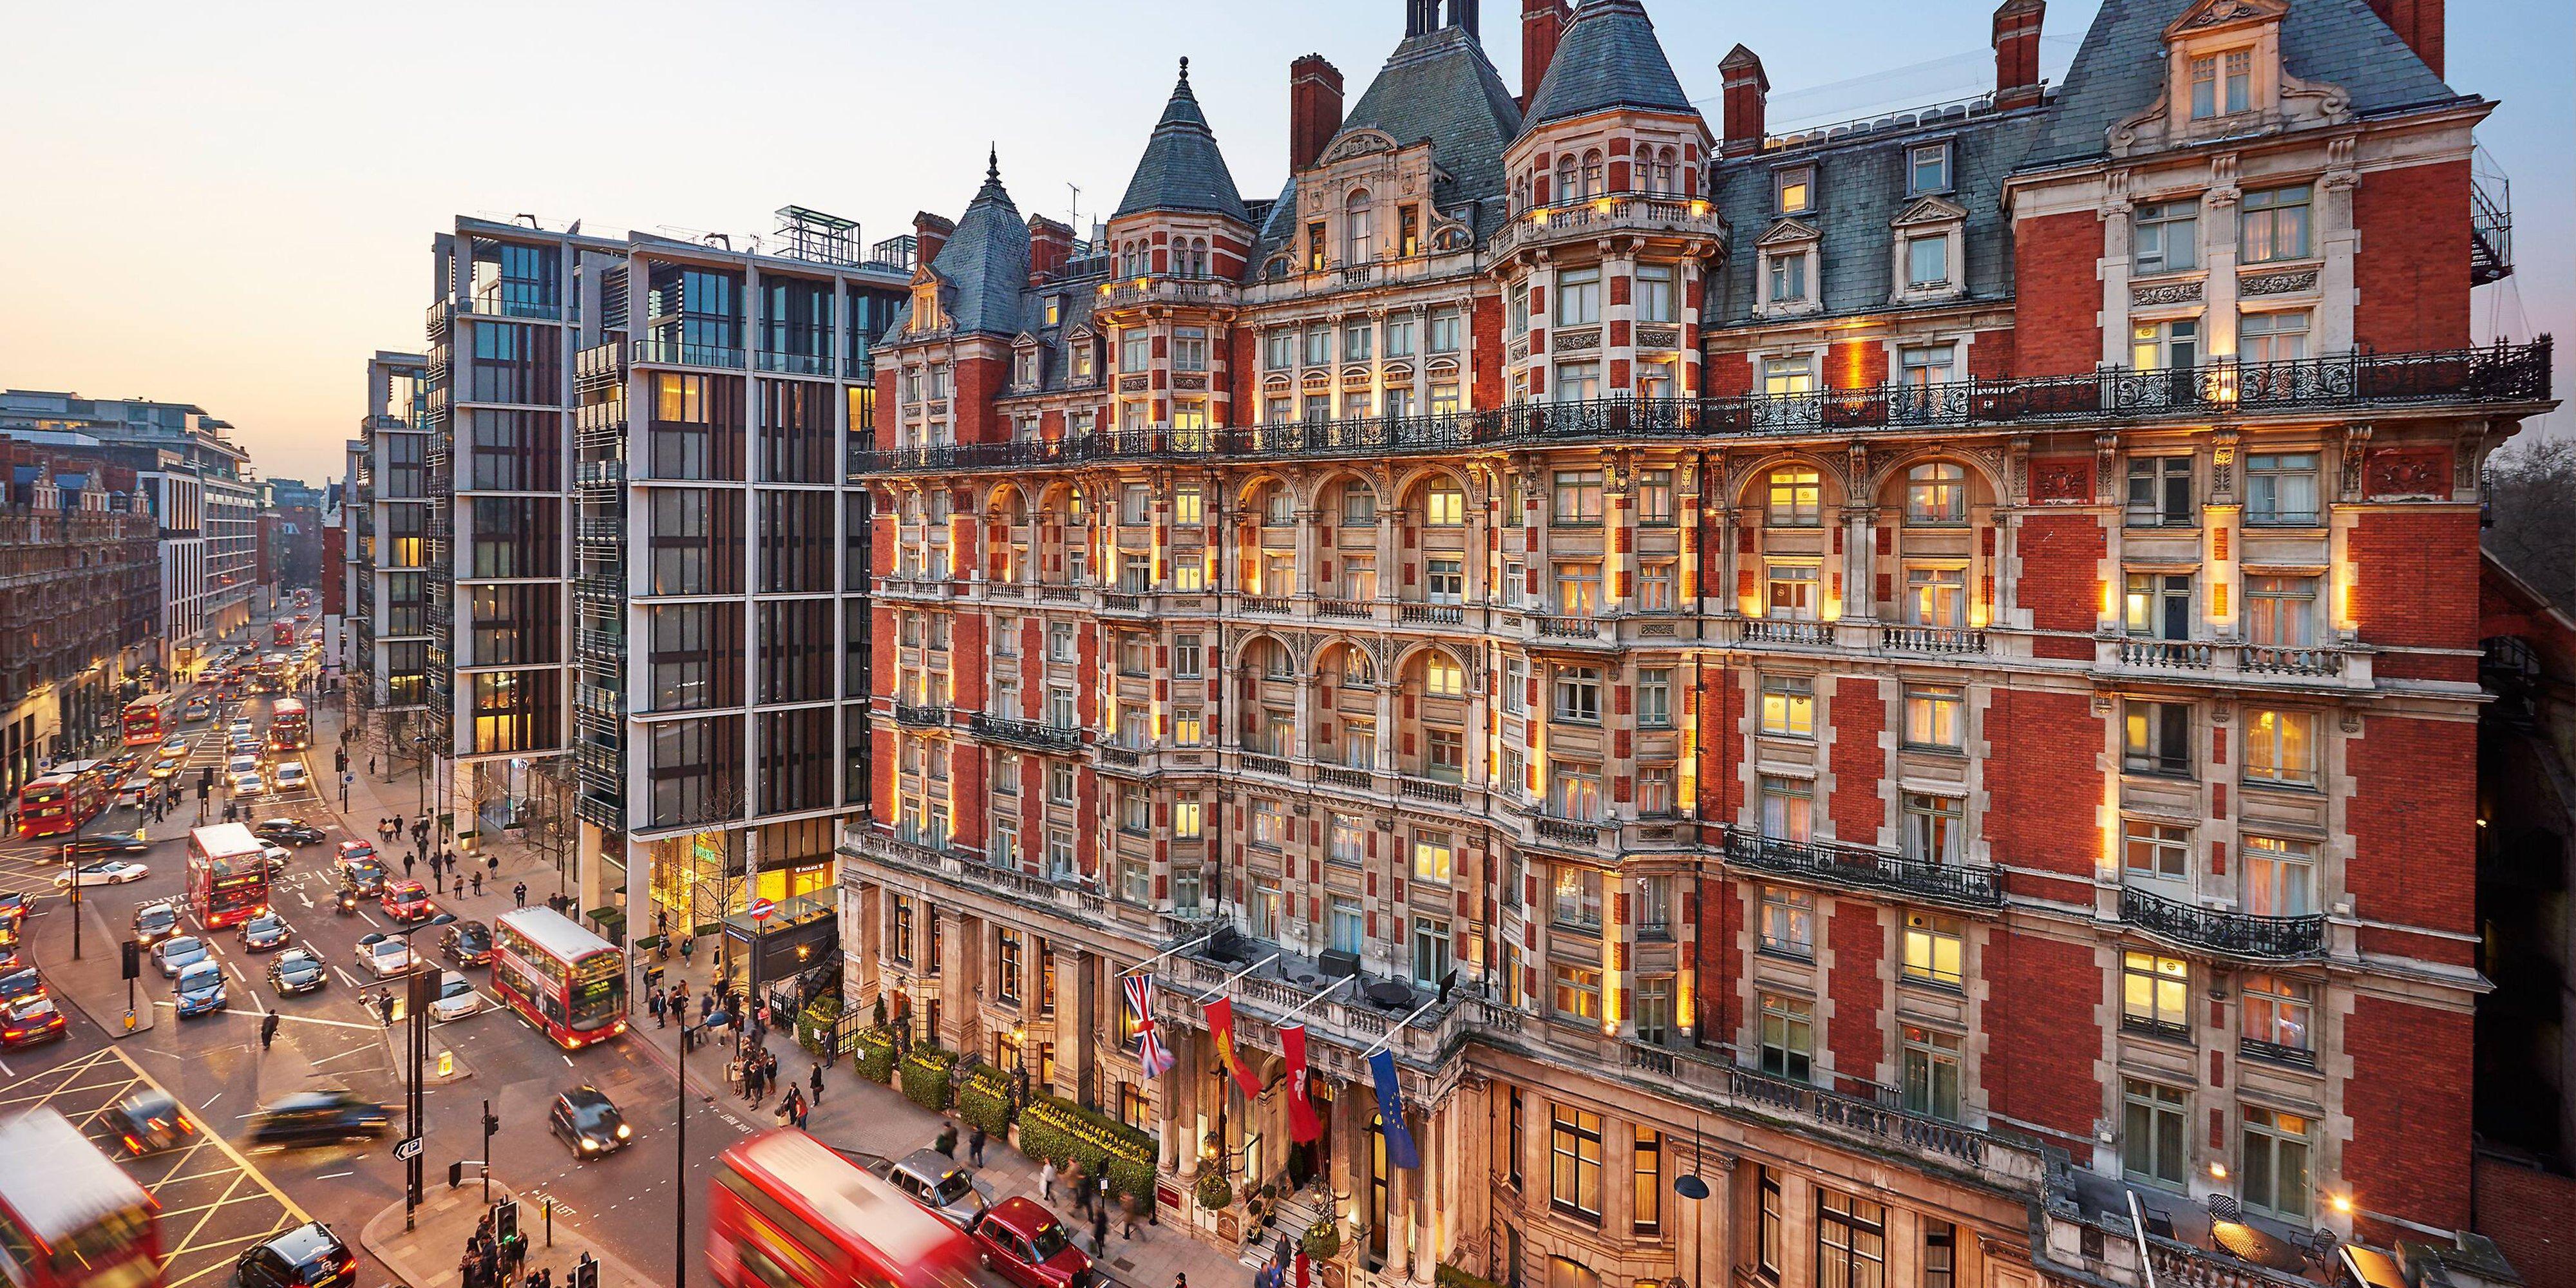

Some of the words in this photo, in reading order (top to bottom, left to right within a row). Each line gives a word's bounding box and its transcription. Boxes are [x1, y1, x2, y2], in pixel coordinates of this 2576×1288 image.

[273, 872, 312, 884] EAS
[277, 883, 305, 893] A4
[410, 1141, 418, 1151] P
[536, 1193, 559, 1205] LOOK
[553, 1203, 576, 1217] LEFT
